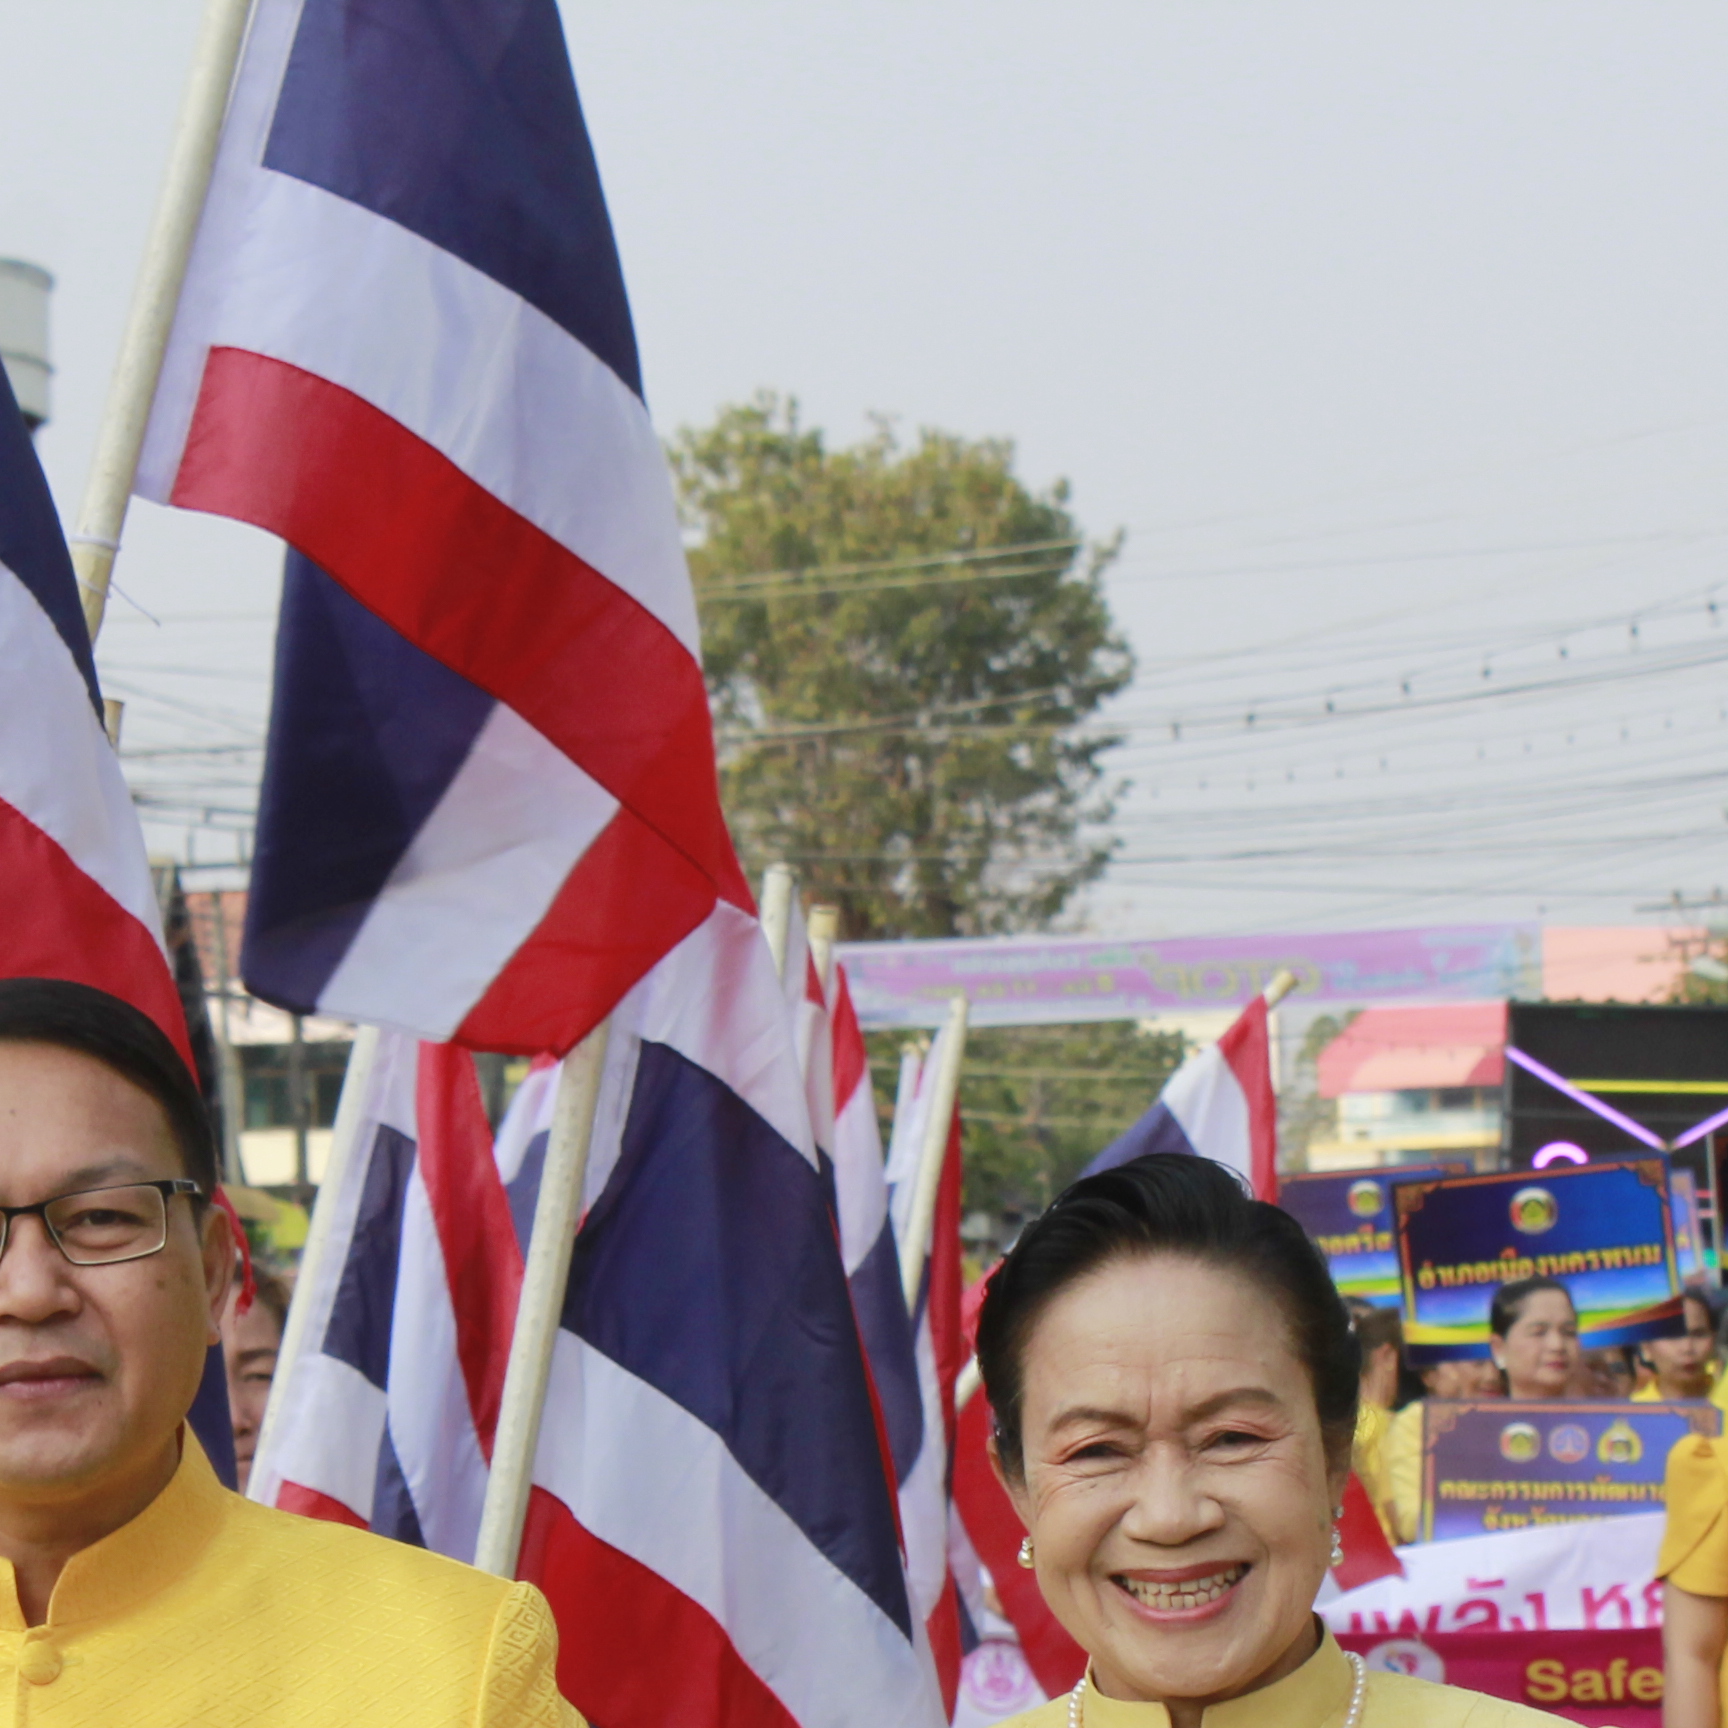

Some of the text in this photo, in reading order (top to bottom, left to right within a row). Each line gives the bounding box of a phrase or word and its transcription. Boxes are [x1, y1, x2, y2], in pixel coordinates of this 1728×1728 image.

[1418, 1244, 1662, 1290] อำเภอเมืองนครพนม
[1524, 1657, 1664, 1703] Safe
